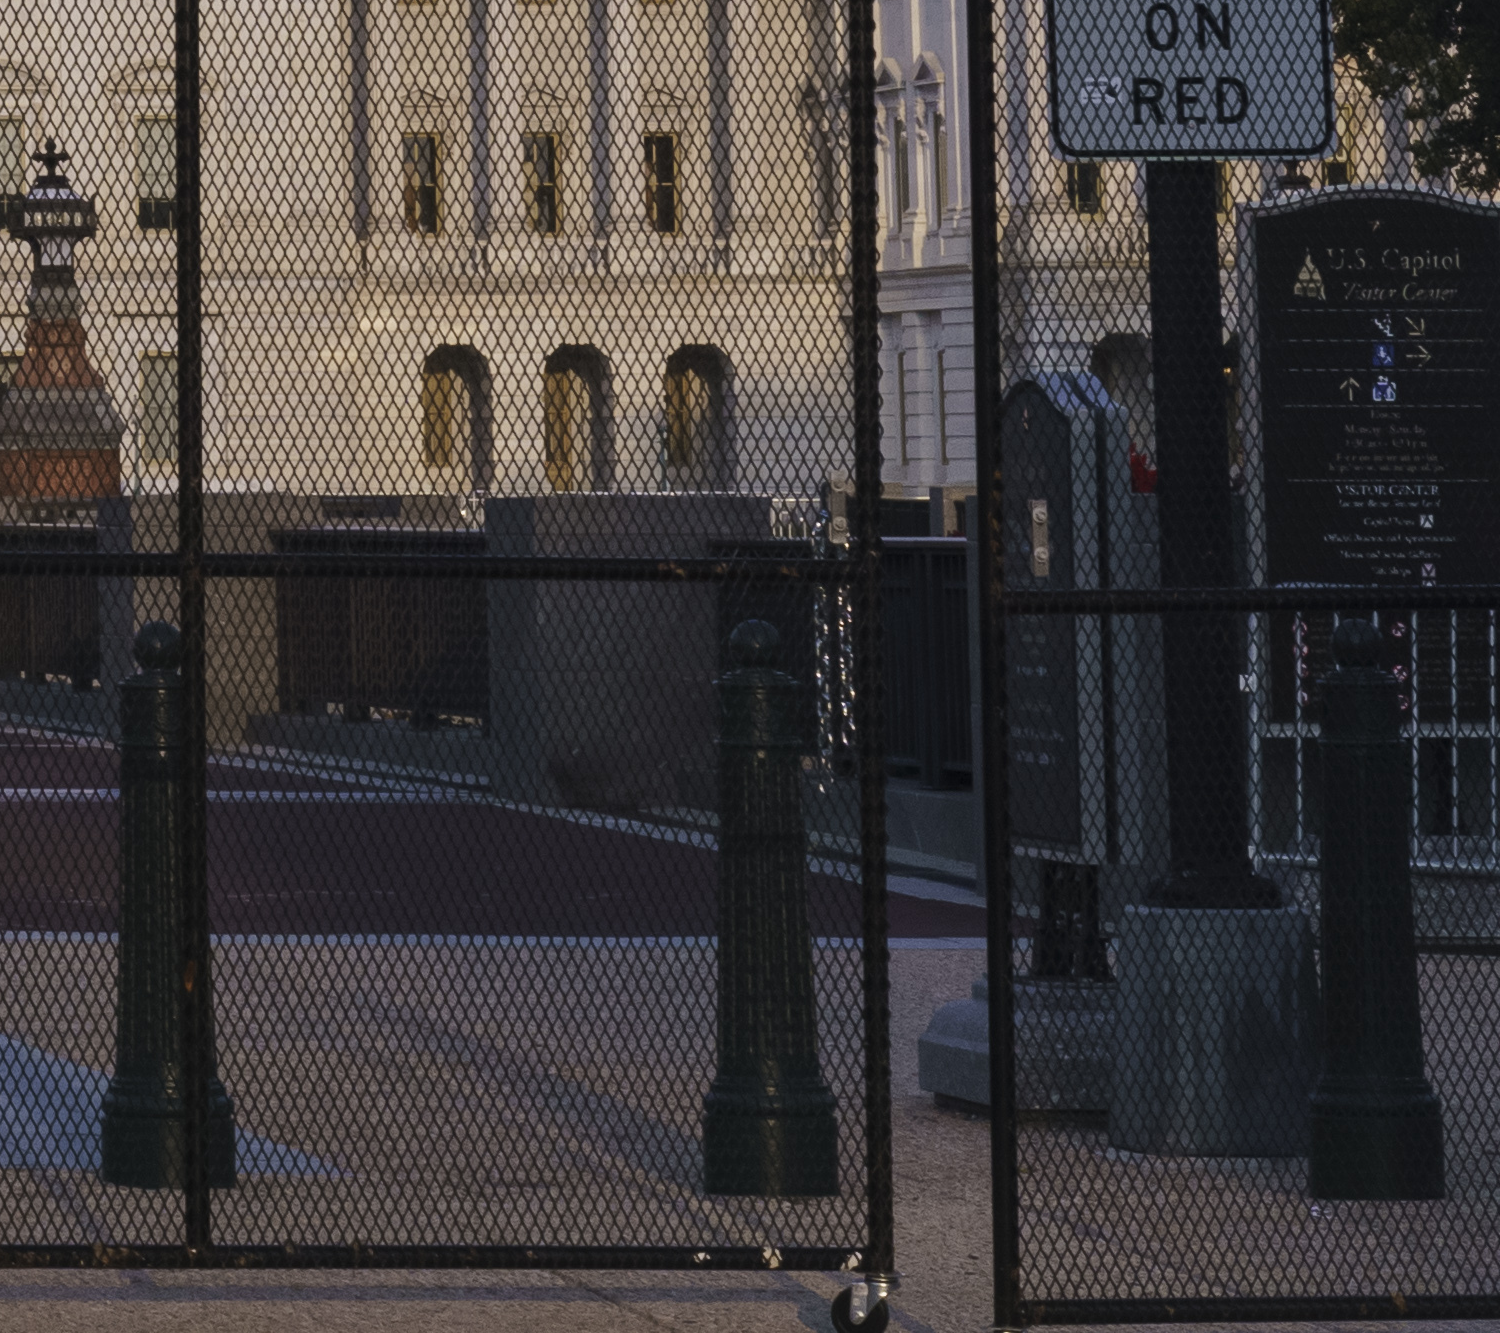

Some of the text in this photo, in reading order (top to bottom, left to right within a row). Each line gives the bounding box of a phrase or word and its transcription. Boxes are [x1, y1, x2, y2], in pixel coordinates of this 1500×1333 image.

[1145, 2, 1231, 52] ON
[1132, 77, 1250, 126] RED
[1382, 247, 1462, 276] Capitol
